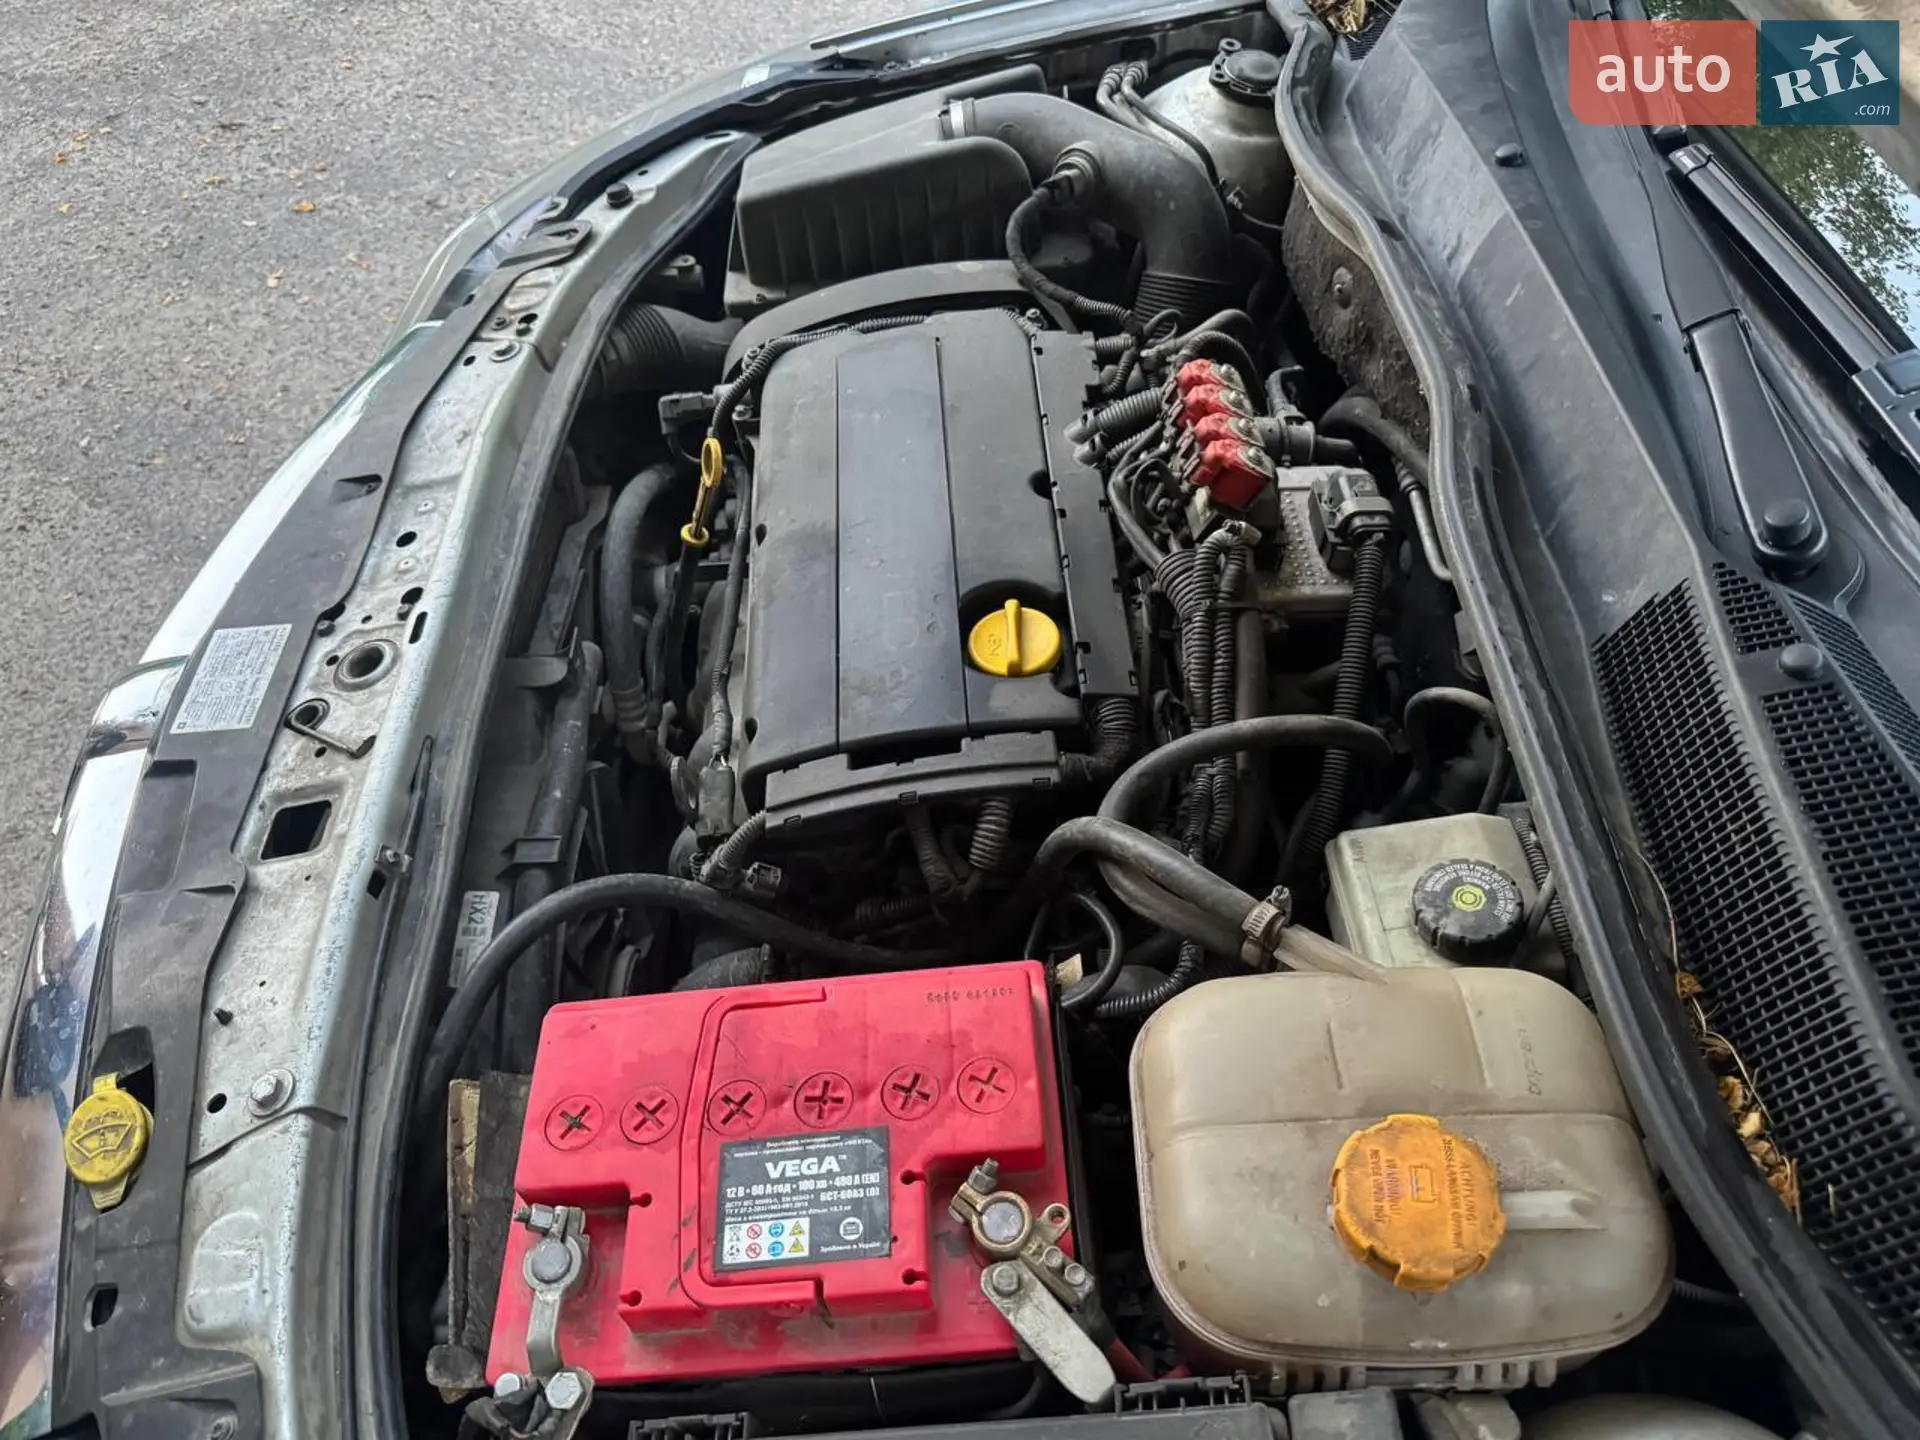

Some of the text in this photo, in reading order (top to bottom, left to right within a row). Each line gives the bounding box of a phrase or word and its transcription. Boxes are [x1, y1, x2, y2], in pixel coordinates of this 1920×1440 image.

[467, 894, 488, 925] HX2
[765, 1156, 840, 1179] VEGA
[726, 1187, 737, 1198] 12
